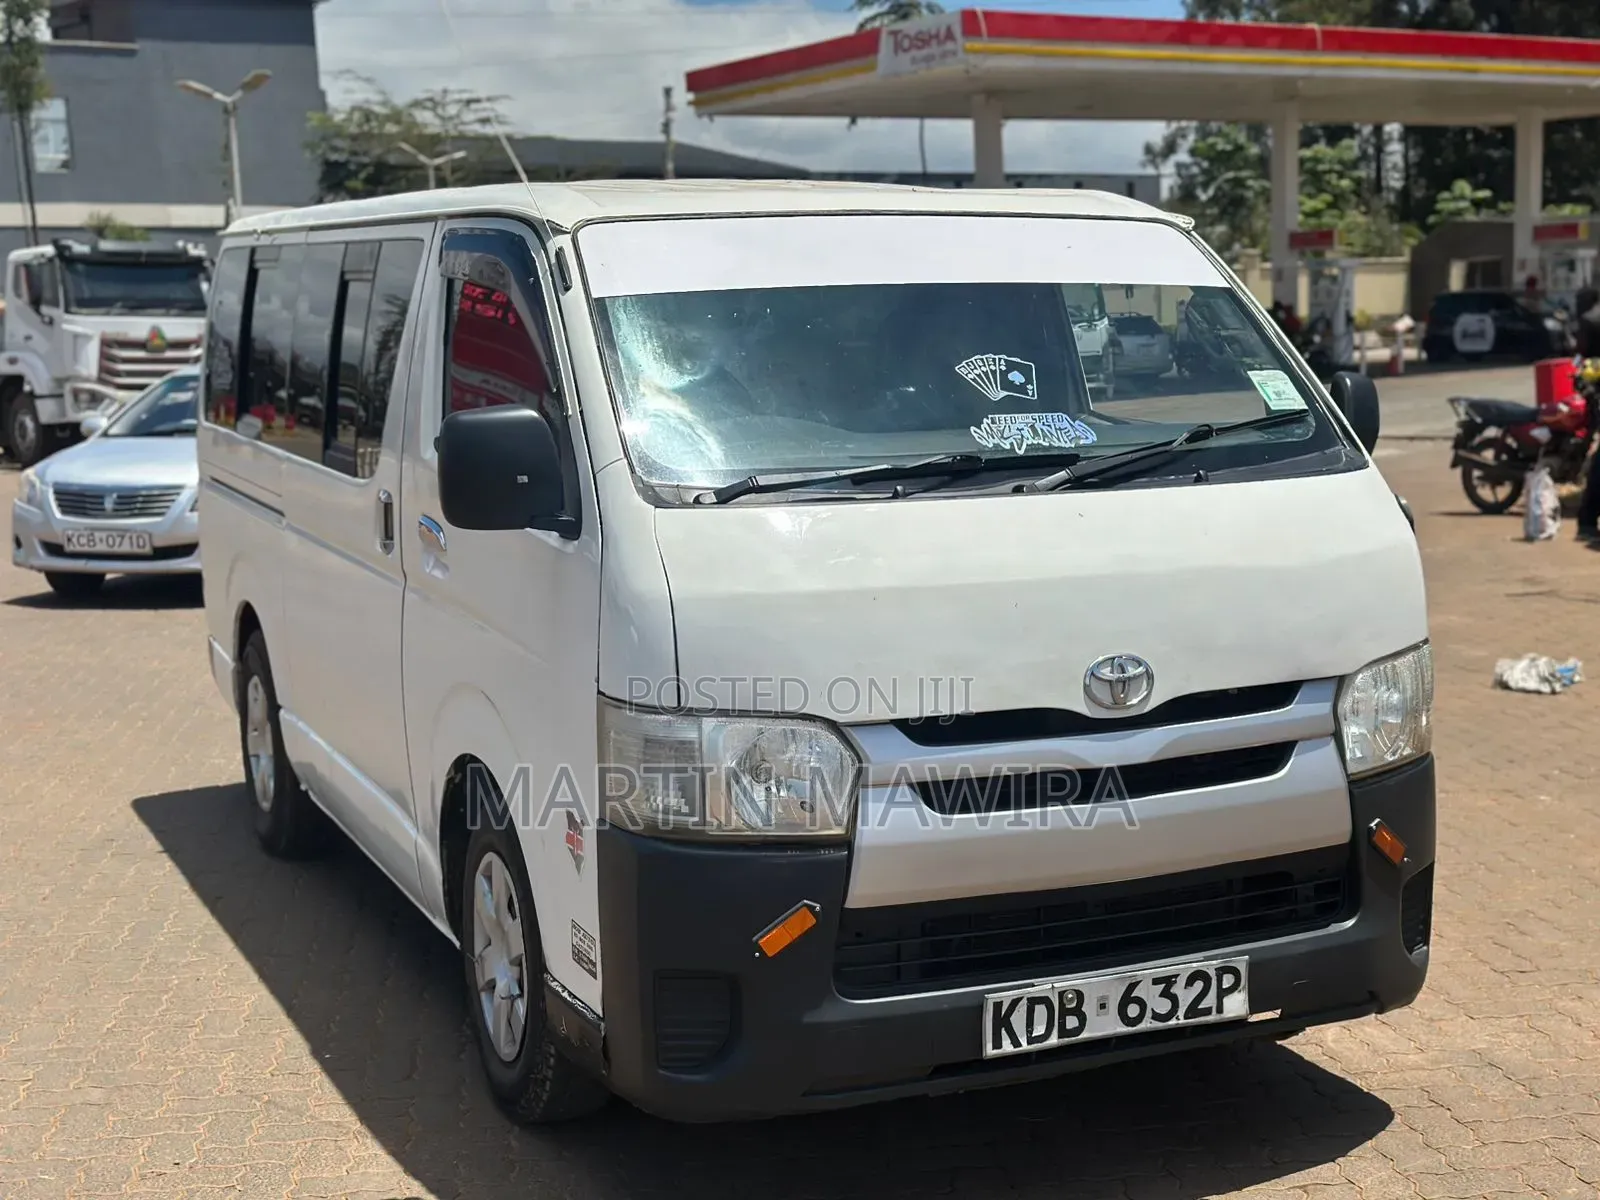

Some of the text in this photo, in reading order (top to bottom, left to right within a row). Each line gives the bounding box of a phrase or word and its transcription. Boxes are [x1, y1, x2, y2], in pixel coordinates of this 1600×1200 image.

[888, 25, 957, 56] TOSHA
[1031, 413, 1064, 424] SPEED
[66, 532, 96, 548] KCB
[991, 965, 1243, 1050] KDB 632P
